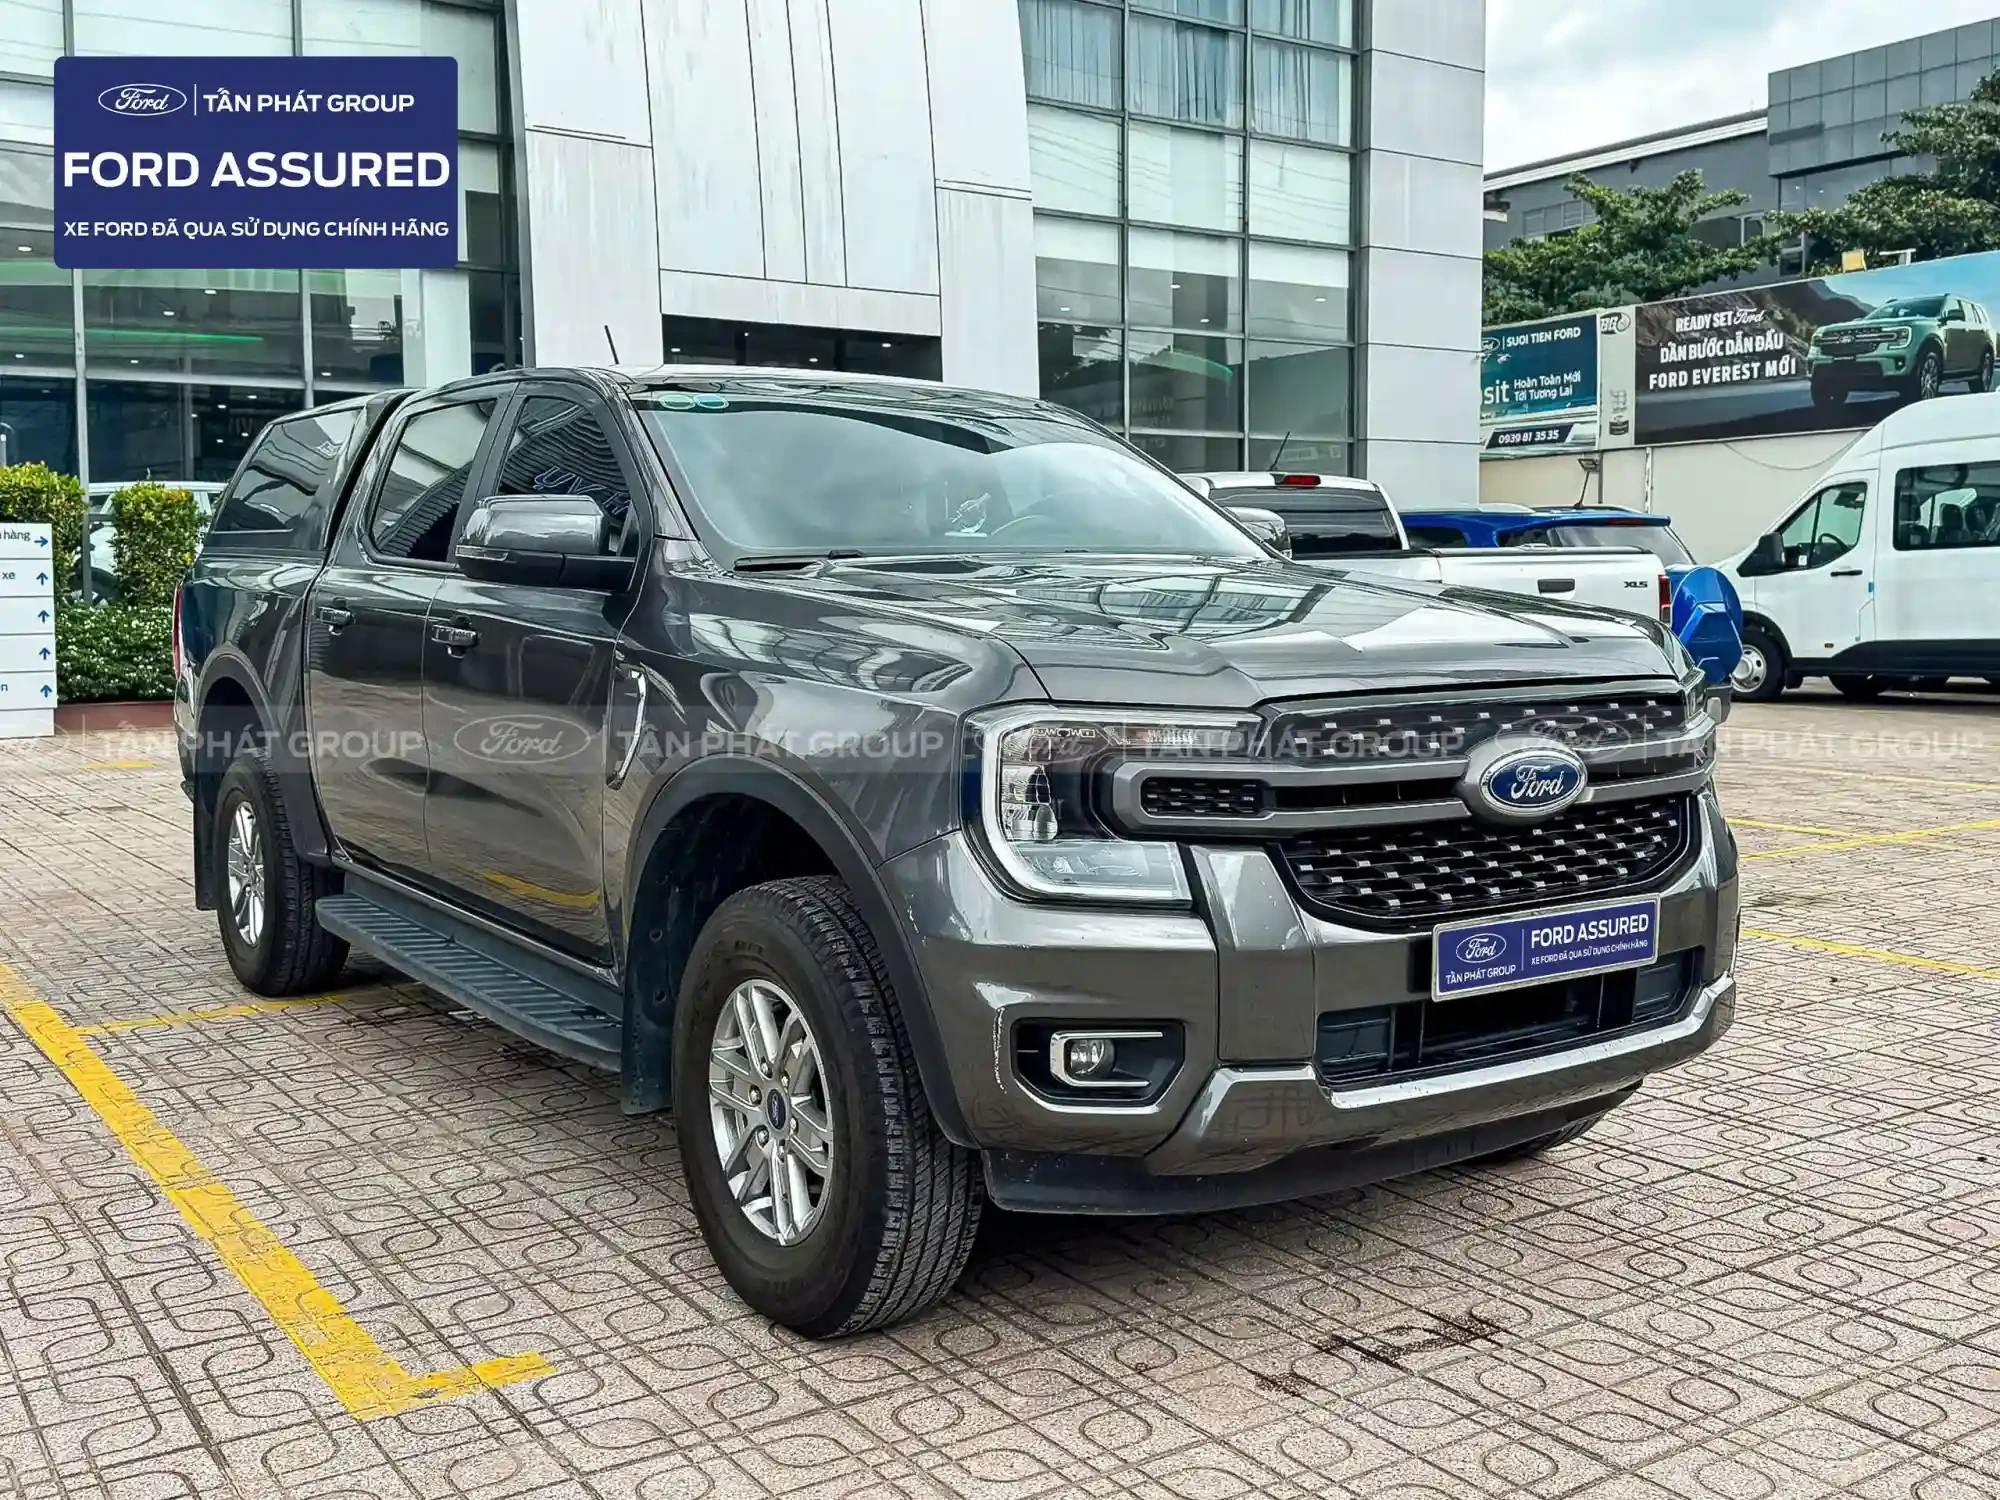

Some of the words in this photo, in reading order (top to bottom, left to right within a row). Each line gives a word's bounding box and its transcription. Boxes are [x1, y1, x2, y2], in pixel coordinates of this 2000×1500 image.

[1676, 314, 1711, 332] READY
[1713, 311, 1734, 327] SET
[1734, 307, 1766, 325] Ford
[1506, 335, 1528, 347] SUOI
[1531, 332, 1552, 344] TIEN
[1553, 327, 1581, 341] FORD
[1513, 376, 1538, 389] Hoàn
[1539, 374, 1561, 387] Toàn
[1649, 370, 1688, 390] FORD
[1692, 362, 1760, 385] EVEREST
[1765, 354, 1796, 377] MỚI
[1559, 384, 1573, 397] Lai
[1498, 433, 1521, 444] 0939
[1510, 764, 1565, 800] Ford
[1531, 924, 1574, 949] FORD
[1577, 913, 1649, 942] ASSURED
[1465, 937, 1497, 960] Ford
[1531, 956, 1540, 965] XE
[1540, 954, 1559, 964] FORD
[1569, 950, 1582, 961] QUA
[1593, 945, 1610, 956] DỤNG
[1610, 943, 1630, 953] CHÍNH
[1464, 967, 1487, 982] PHÁT
[1487, 964, 1517, 978] GROUP
